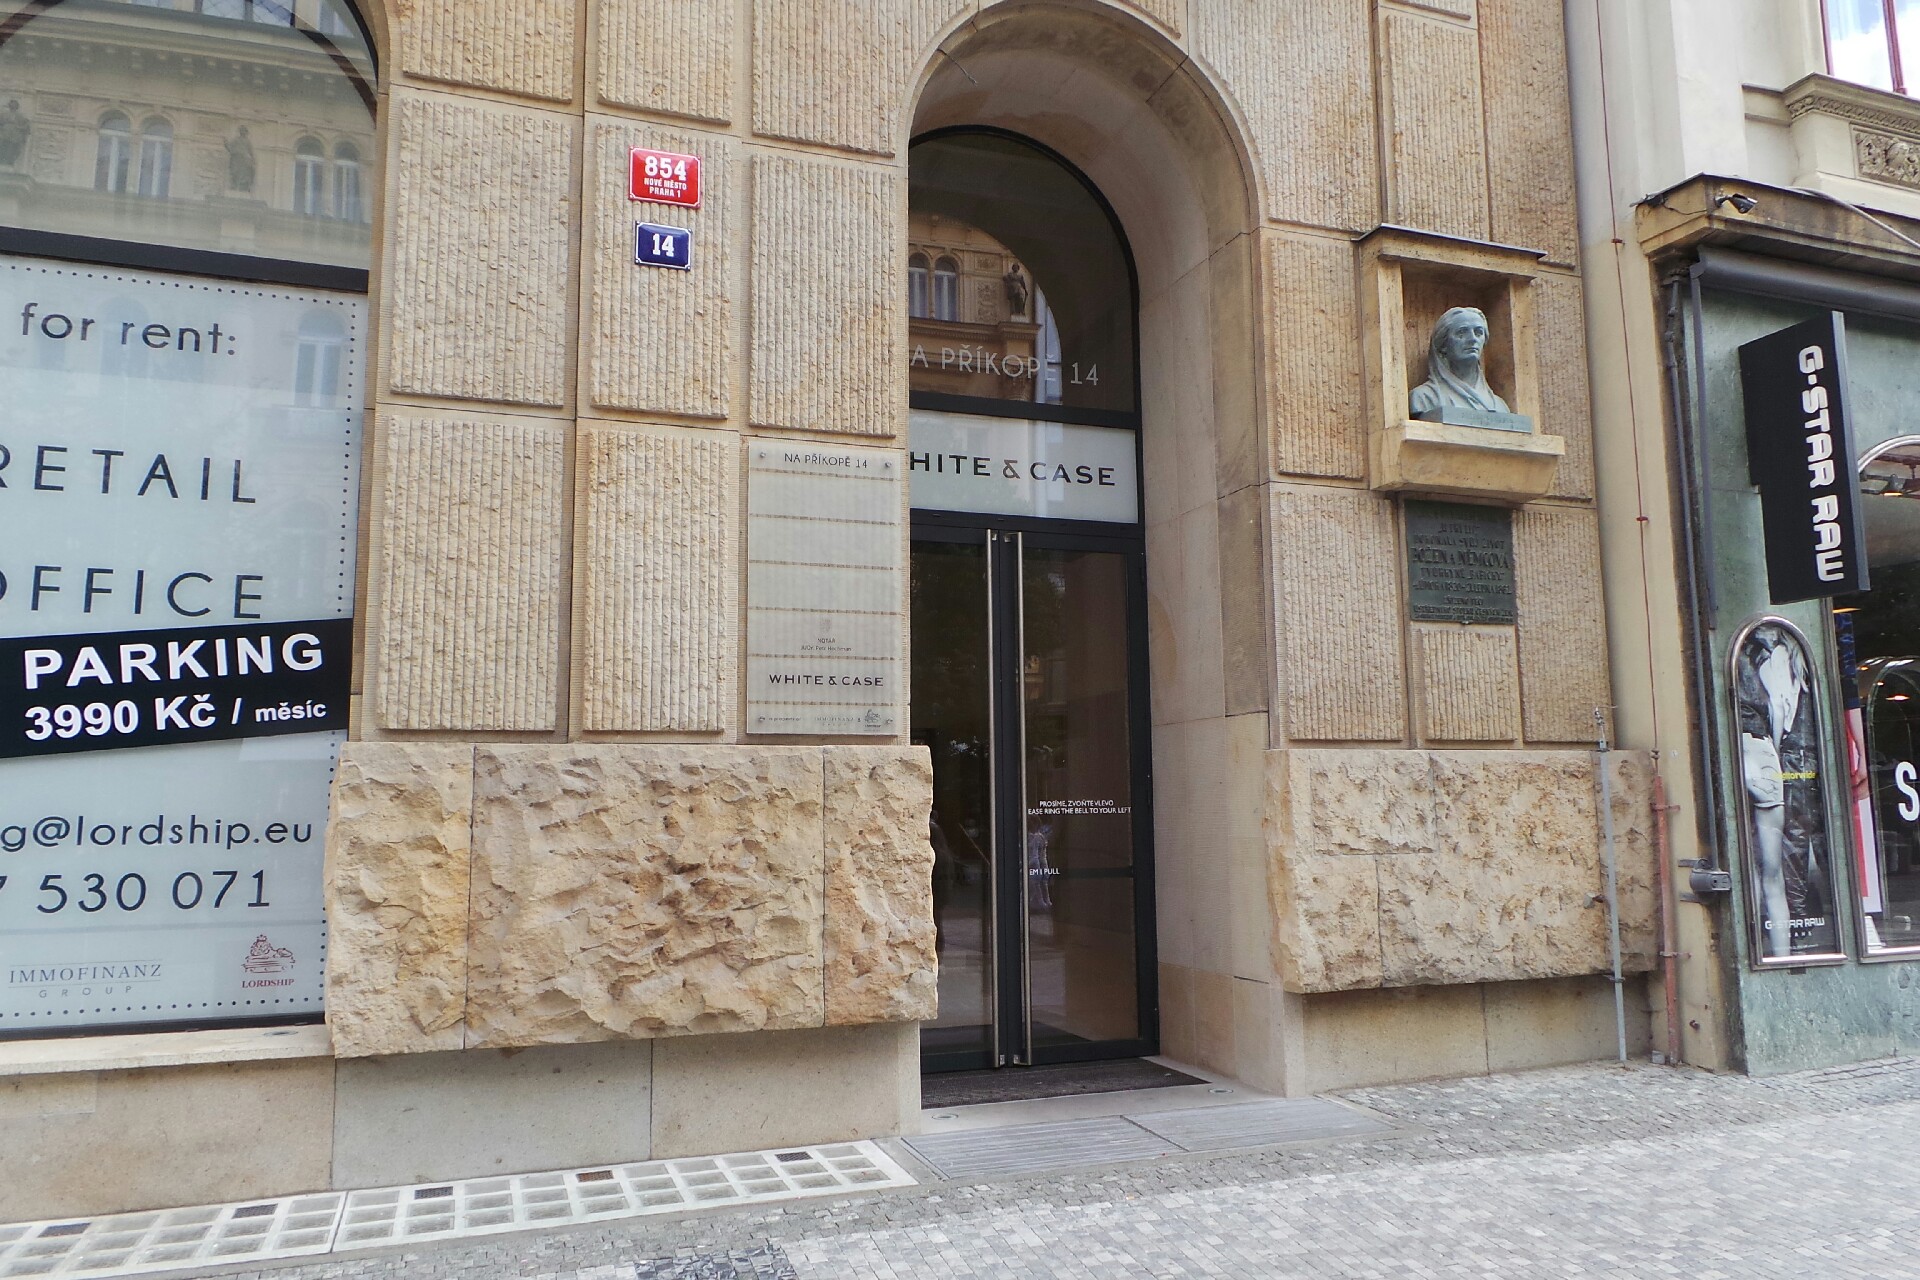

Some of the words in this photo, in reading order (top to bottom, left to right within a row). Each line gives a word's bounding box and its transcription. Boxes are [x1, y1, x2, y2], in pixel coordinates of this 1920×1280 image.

[644, 156, 687, 181] 854
[644, 178, 662, 187] NOVÉ
[664, 179, 687, 190] MĚSTO
[649, 186, 675, 196] PRAHA
[677, 190, 681, 198] 1
[652, 233, 675, 257] 14
[21, 302, 95, 341] for
[121, 321, 236, 356] rent:
[941, 343, 1058, 381] PŘÍKOPĚ
[1070, 361, 1099, 386] 14
[784, 453, 800, 464] NA
[805, 453, 851, 467] PŘÍKOPĚ
[856, 459, 868, 469] 14
[1002, 459, 1021, 480] &
[1029, 461, 1115, 487] CASE
[1812, 494, 1845, 582] RAW
[0, 565, 263, 619] FFICE
[23, 633, 323, 690] PARKING
[769, 674, 824, 685] WHITE
[828, 675, 838, 686] &
[841, 676, 884, 687] CASE
[25, 700, 139, 740] 3990
[154, 694, 216, 730] Kč
[255, 700, 327, 722] měsíc
[0, 814, 312, 853] g@lordship.eu
[36, 872, 147, 914] 530
[172, 869, 270, 910] 071
[1804, 917, 1825, 928] RAW
[9, 963, 162, 984] IMMOFINANZ
[241, 978, 295, 989] LORDSHIP
[38, 985, 132, 999] GROUP
